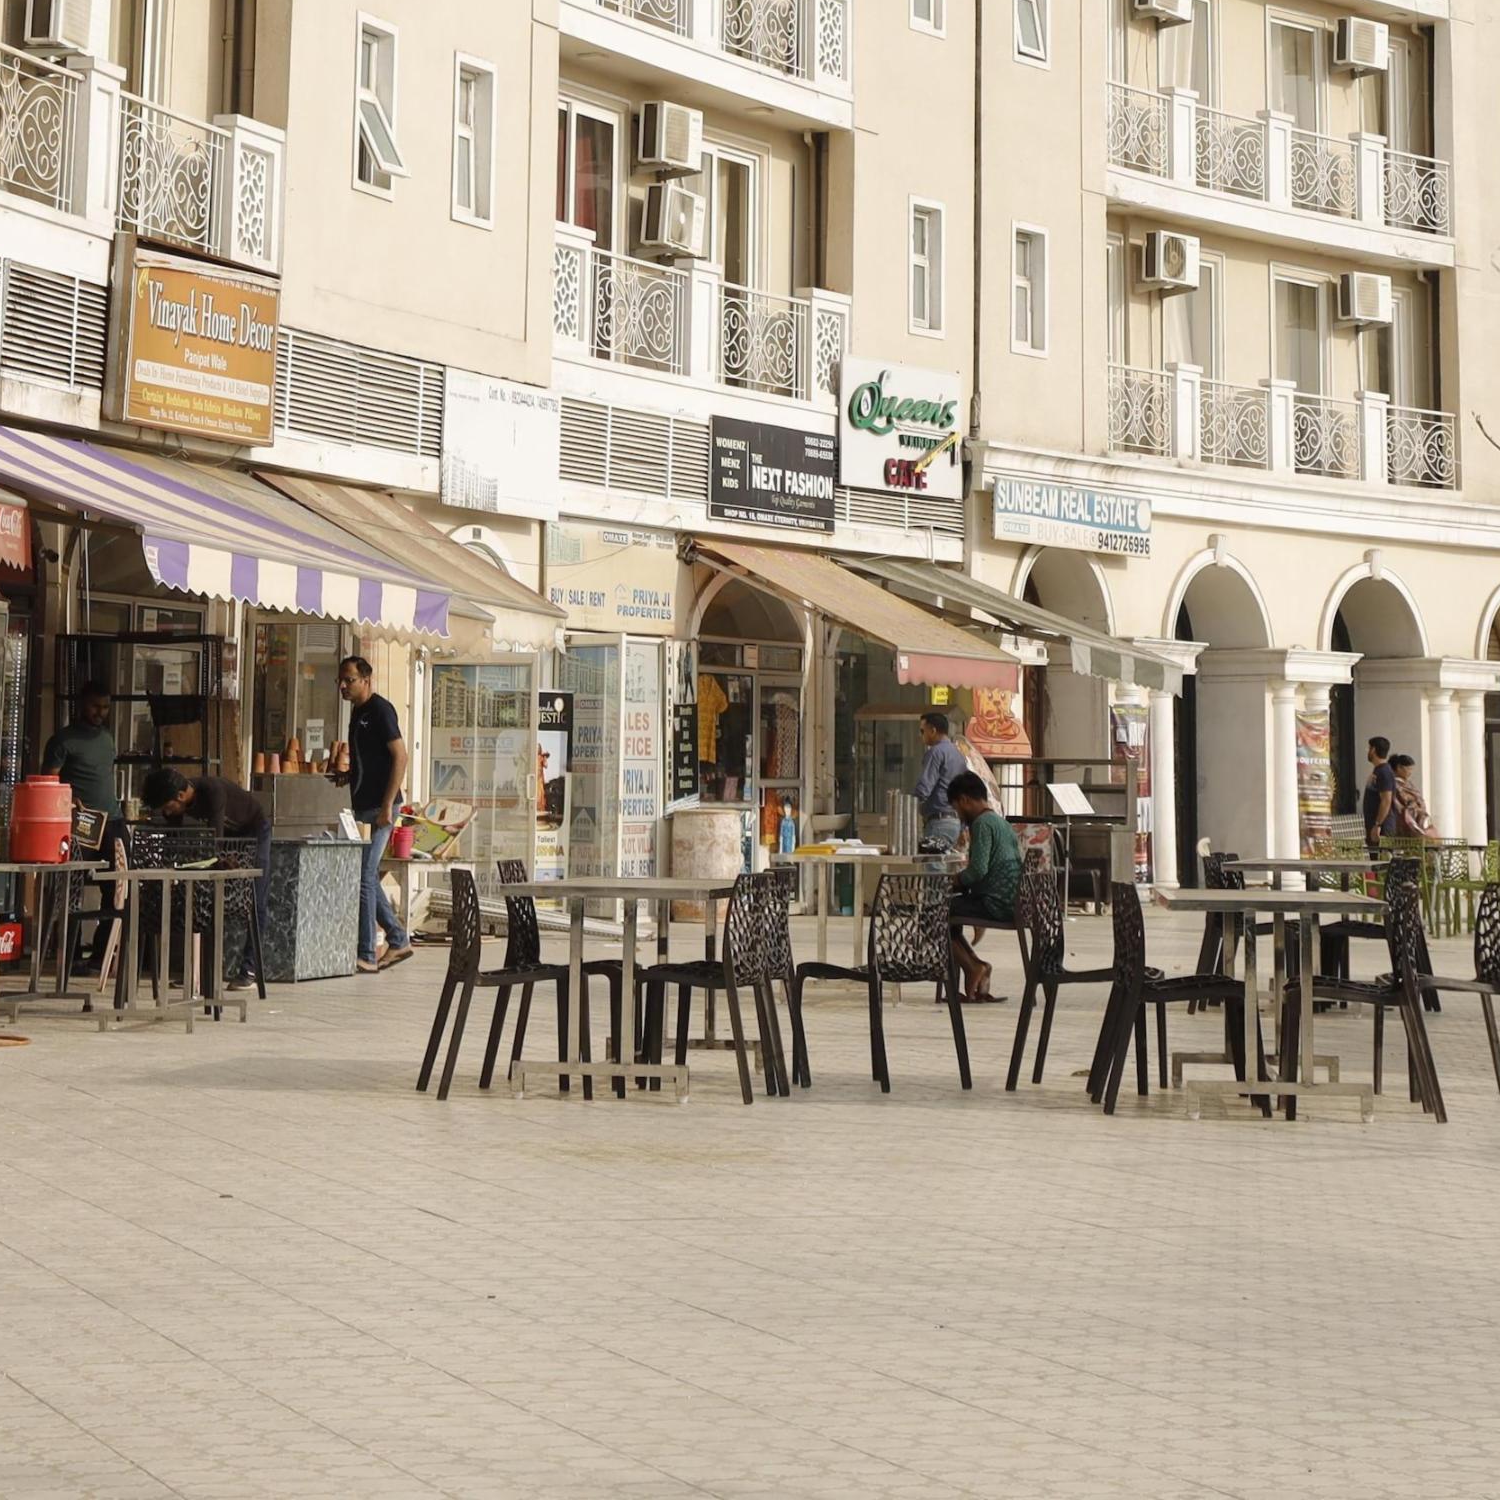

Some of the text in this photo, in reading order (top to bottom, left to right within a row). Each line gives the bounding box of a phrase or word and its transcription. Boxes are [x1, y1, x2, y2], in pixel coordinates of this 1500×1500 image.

[148, 280, 198, 346] Vinayak
[201, 293, 237, 344] Home
[238, 303, 274, 350] Décor
[184, 348, 228, 371] Panipat Wale
[716, 437, 746, 451] WOMENZ
[721, 457, 740, 469] MENZ
[751, 453, 763, 465] THE
[722, 477, 739, 489] KIDS
[752, 465, 834, 500] NEXT FASHION
[724, 508, 738, 518] SHOP
[997, 480, 1136, 528] SUNBEAM REAL ESTATE
[604, 531, 628, 545] OMAXE
[551, 588, 606, 608] BUY SALE RENT
[633, 588, 670, 607] PRIYA JI
[617, 604, 672, 620] PROPERTIES
[578, 726, 603, 744] PRIYA
[645, 769, 654, 795] JI
